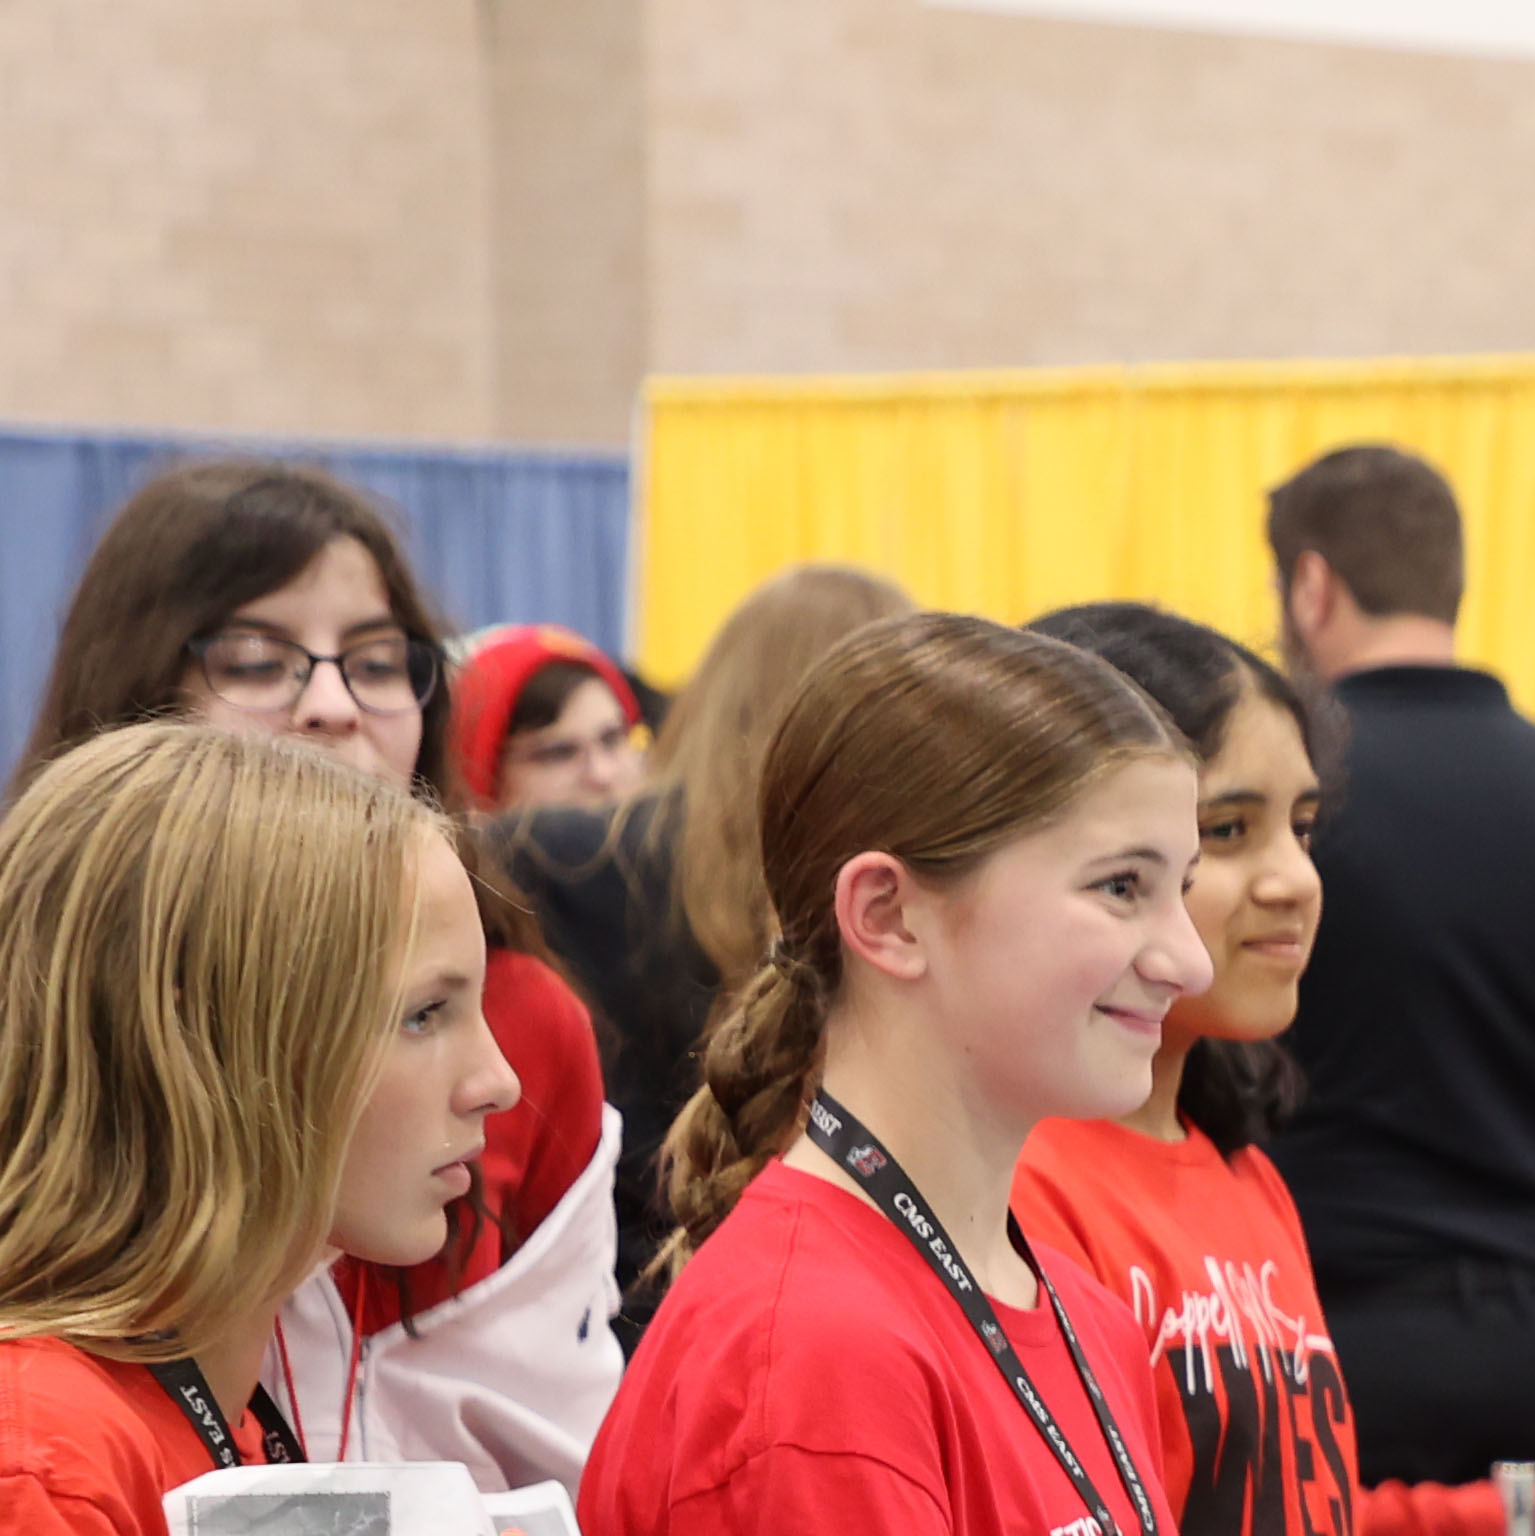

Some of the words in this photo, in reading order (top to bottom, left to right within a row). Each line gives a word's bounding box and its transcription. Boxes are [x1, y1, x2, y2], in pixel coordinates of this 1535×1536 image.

[893, 1192, 935, 1240] CMS
[929, 1235, 973, 1293] EAST
[179, 1384, 226, 1446] EAST
[1016, 1376, 1049, 1424] CMS
